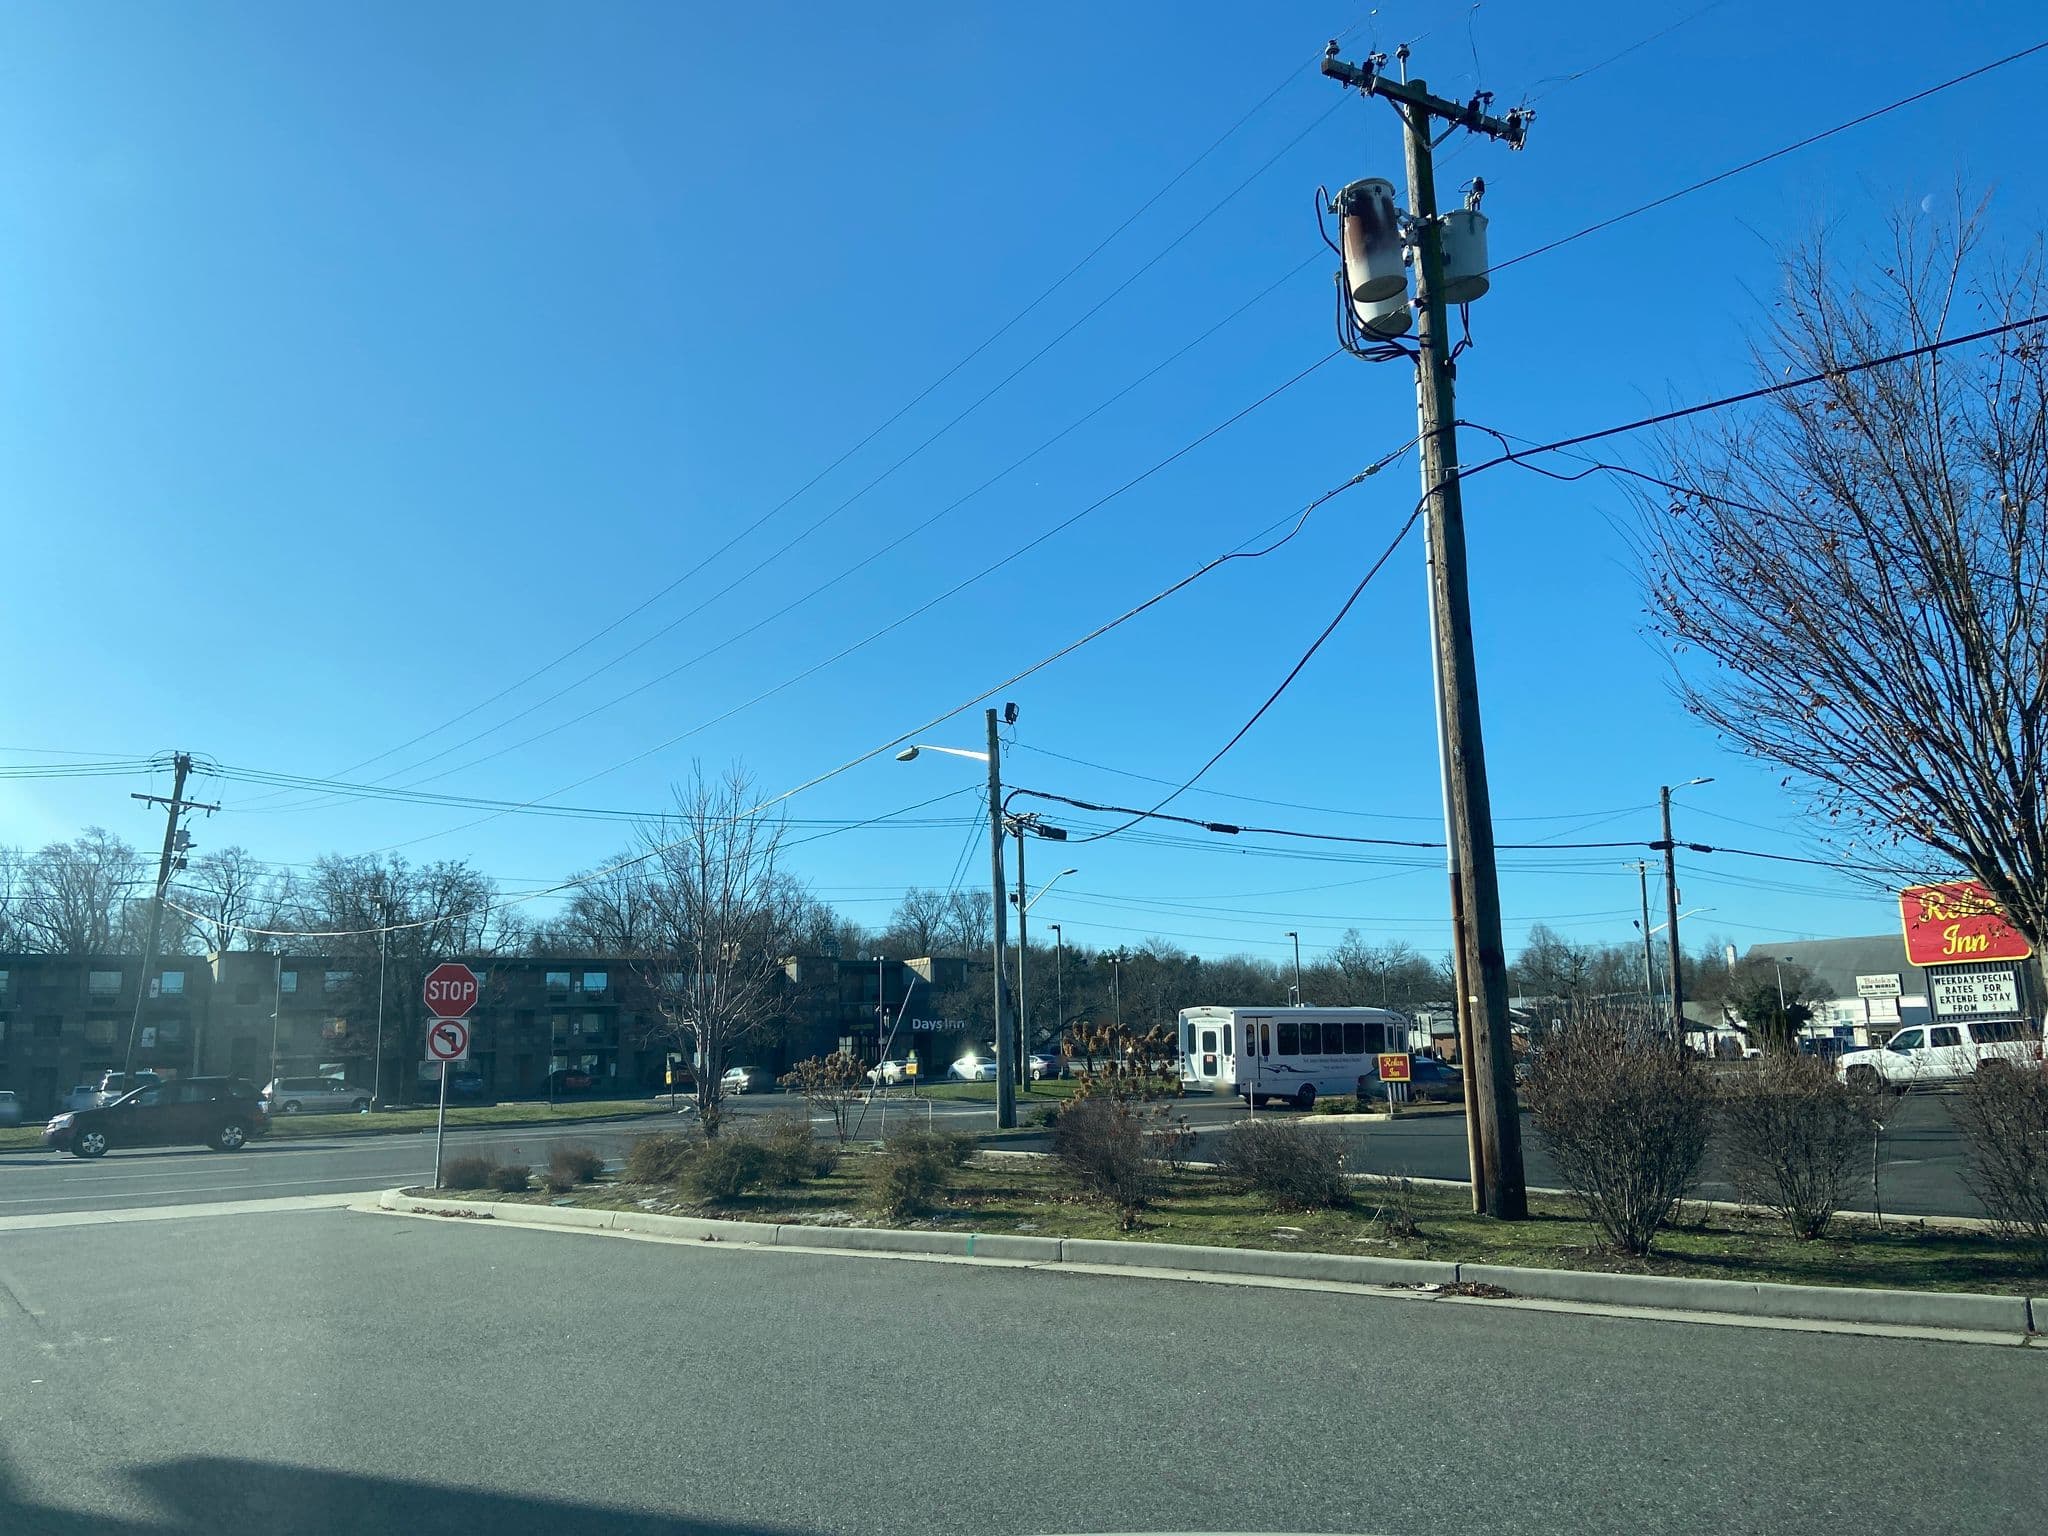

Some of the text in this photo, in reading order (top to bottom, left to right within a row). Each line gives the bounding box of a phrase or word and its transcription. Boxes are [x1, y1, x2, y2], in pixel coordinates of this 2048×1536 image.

[1942, 924, 1989, 955] Inn
[1934, 973, 2014, 985] WEEKDAY SPECIAL
[428, 980, 475, 1001] STOP
[1945, 983, 2002, 995] RATES FOR
[1953, 1004, 1978, 1013] FROM
[912, 1018, 965, 1031] Days Inn
